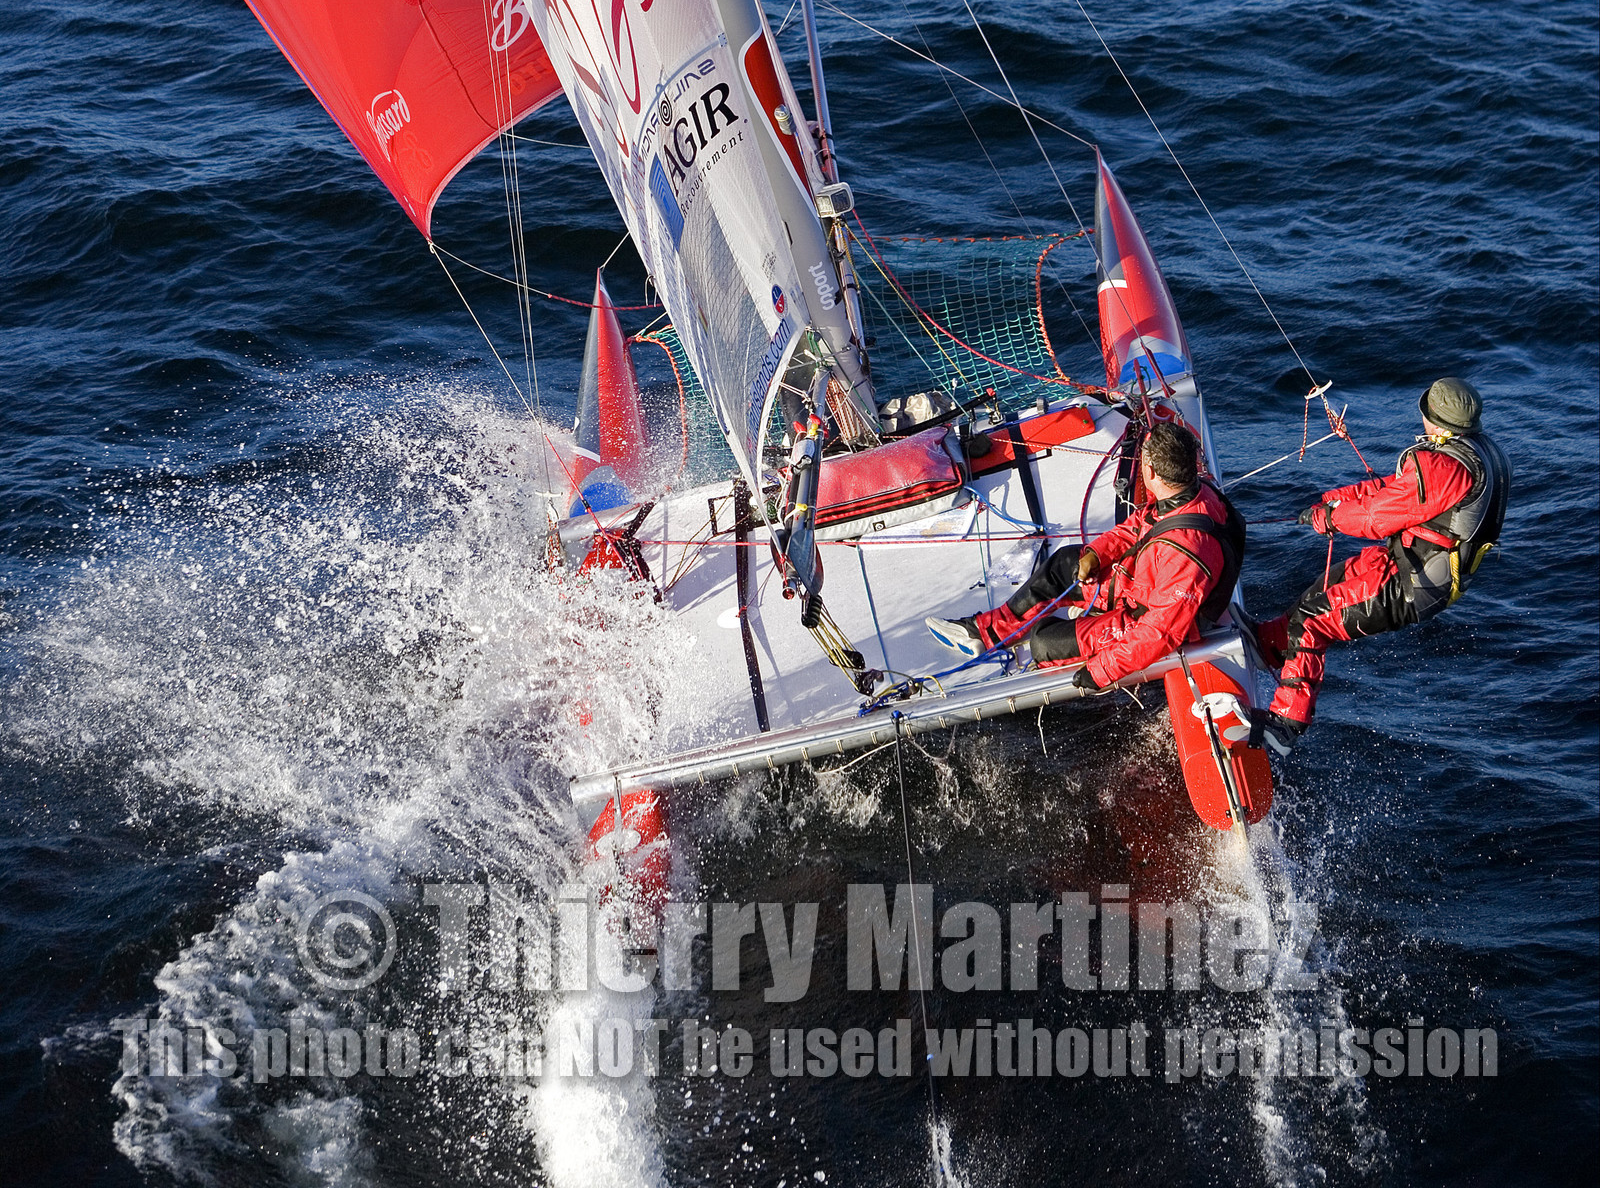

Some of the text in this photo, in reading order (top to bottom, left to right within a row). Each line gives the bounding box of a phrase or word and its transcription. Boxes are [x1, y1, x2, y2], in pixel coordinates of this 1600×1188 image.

[663, 82, 740, 198] AGIR
[680, 129, 744, 218] Recouvrement
[808, 261, 836, 311] sport
